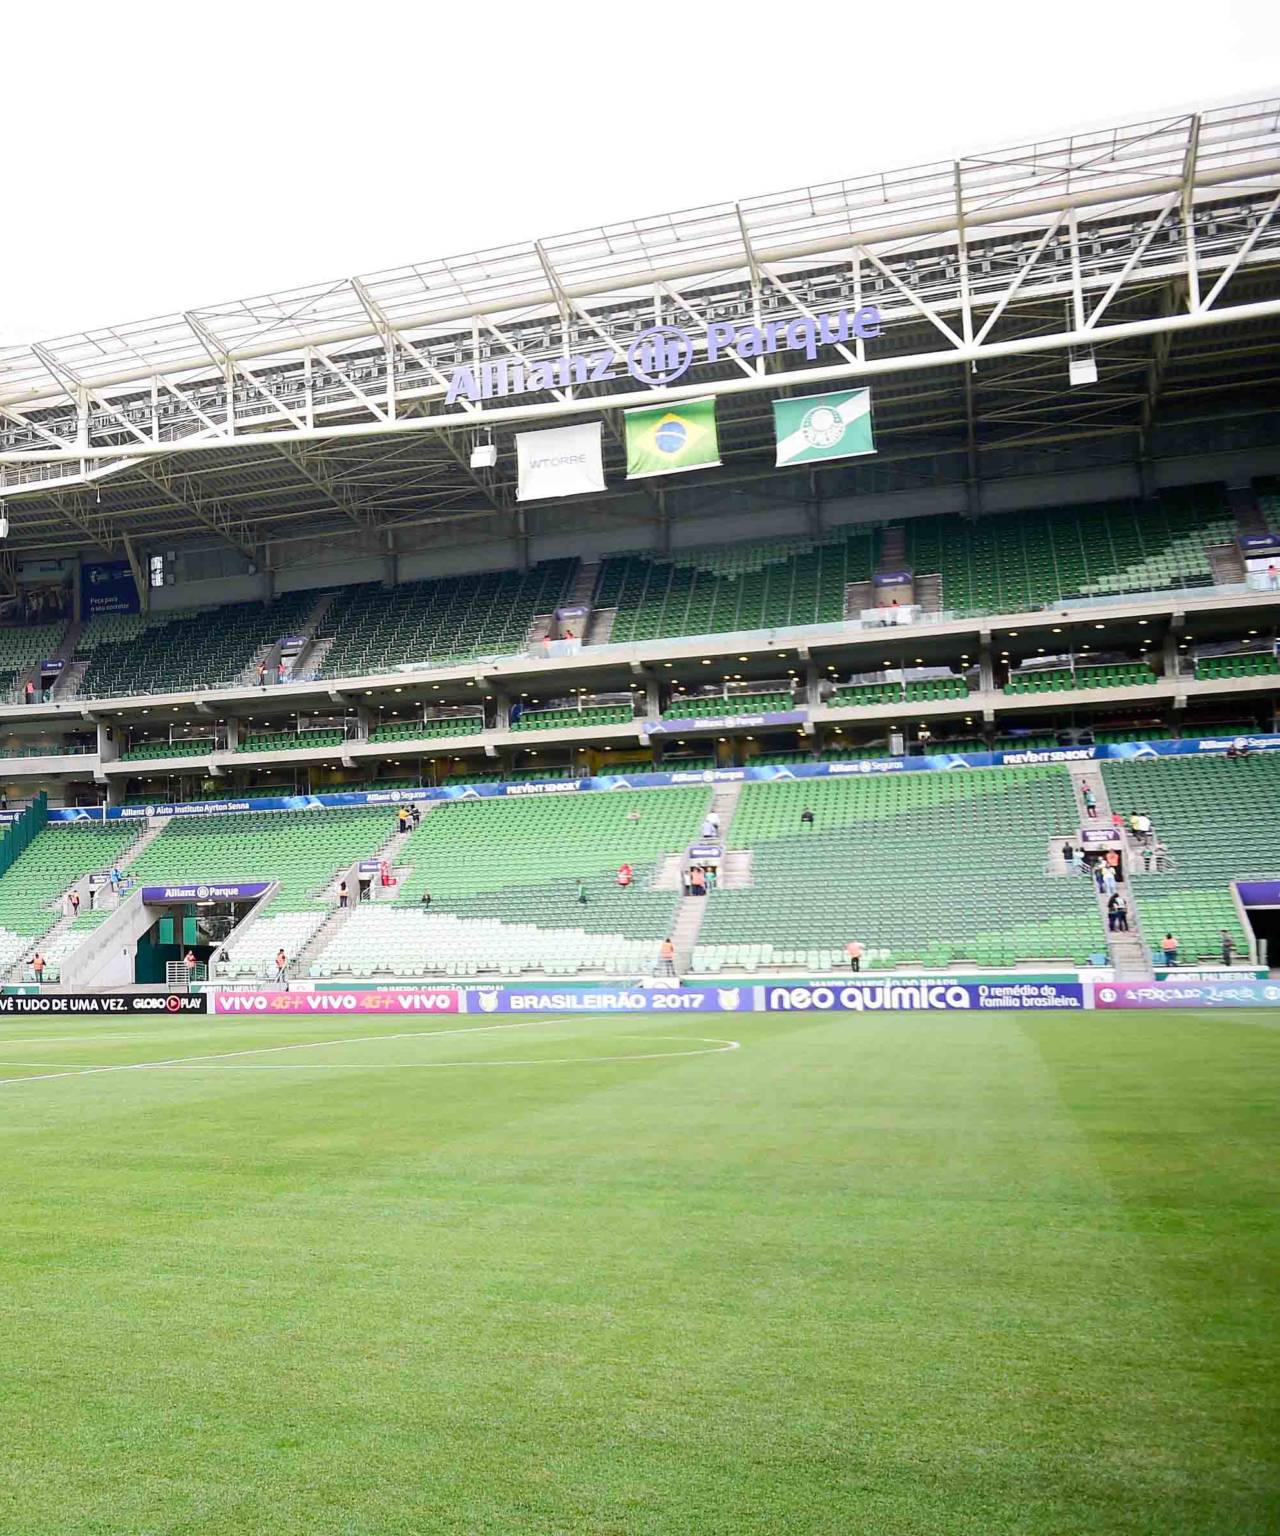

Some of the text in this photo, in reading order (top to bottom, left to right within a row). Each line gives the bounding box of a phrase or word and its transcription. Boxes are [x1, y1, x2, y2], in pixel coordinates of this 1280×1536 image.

[445, 305, 883, 405] Allianz Parque
[528, 453, 588, 470] WTORRE
[121, 803, 250, 817] Allianz Auto Instituto Ayrton Senna
[165, 886, 239, 898] Allianz Parque
[770, 984, 970, 1011] neo química
[979, 985, 989, 996] O
[990, 984, 1038, 996] remédio
[0, 996, 201, 1011] VÊ TUDO DE UMA VEZ. GLOBO PLAY
[510, 991, 705, 1010] BRASILEIRÃO 2017
[979, 995, 1020, 1007] família
